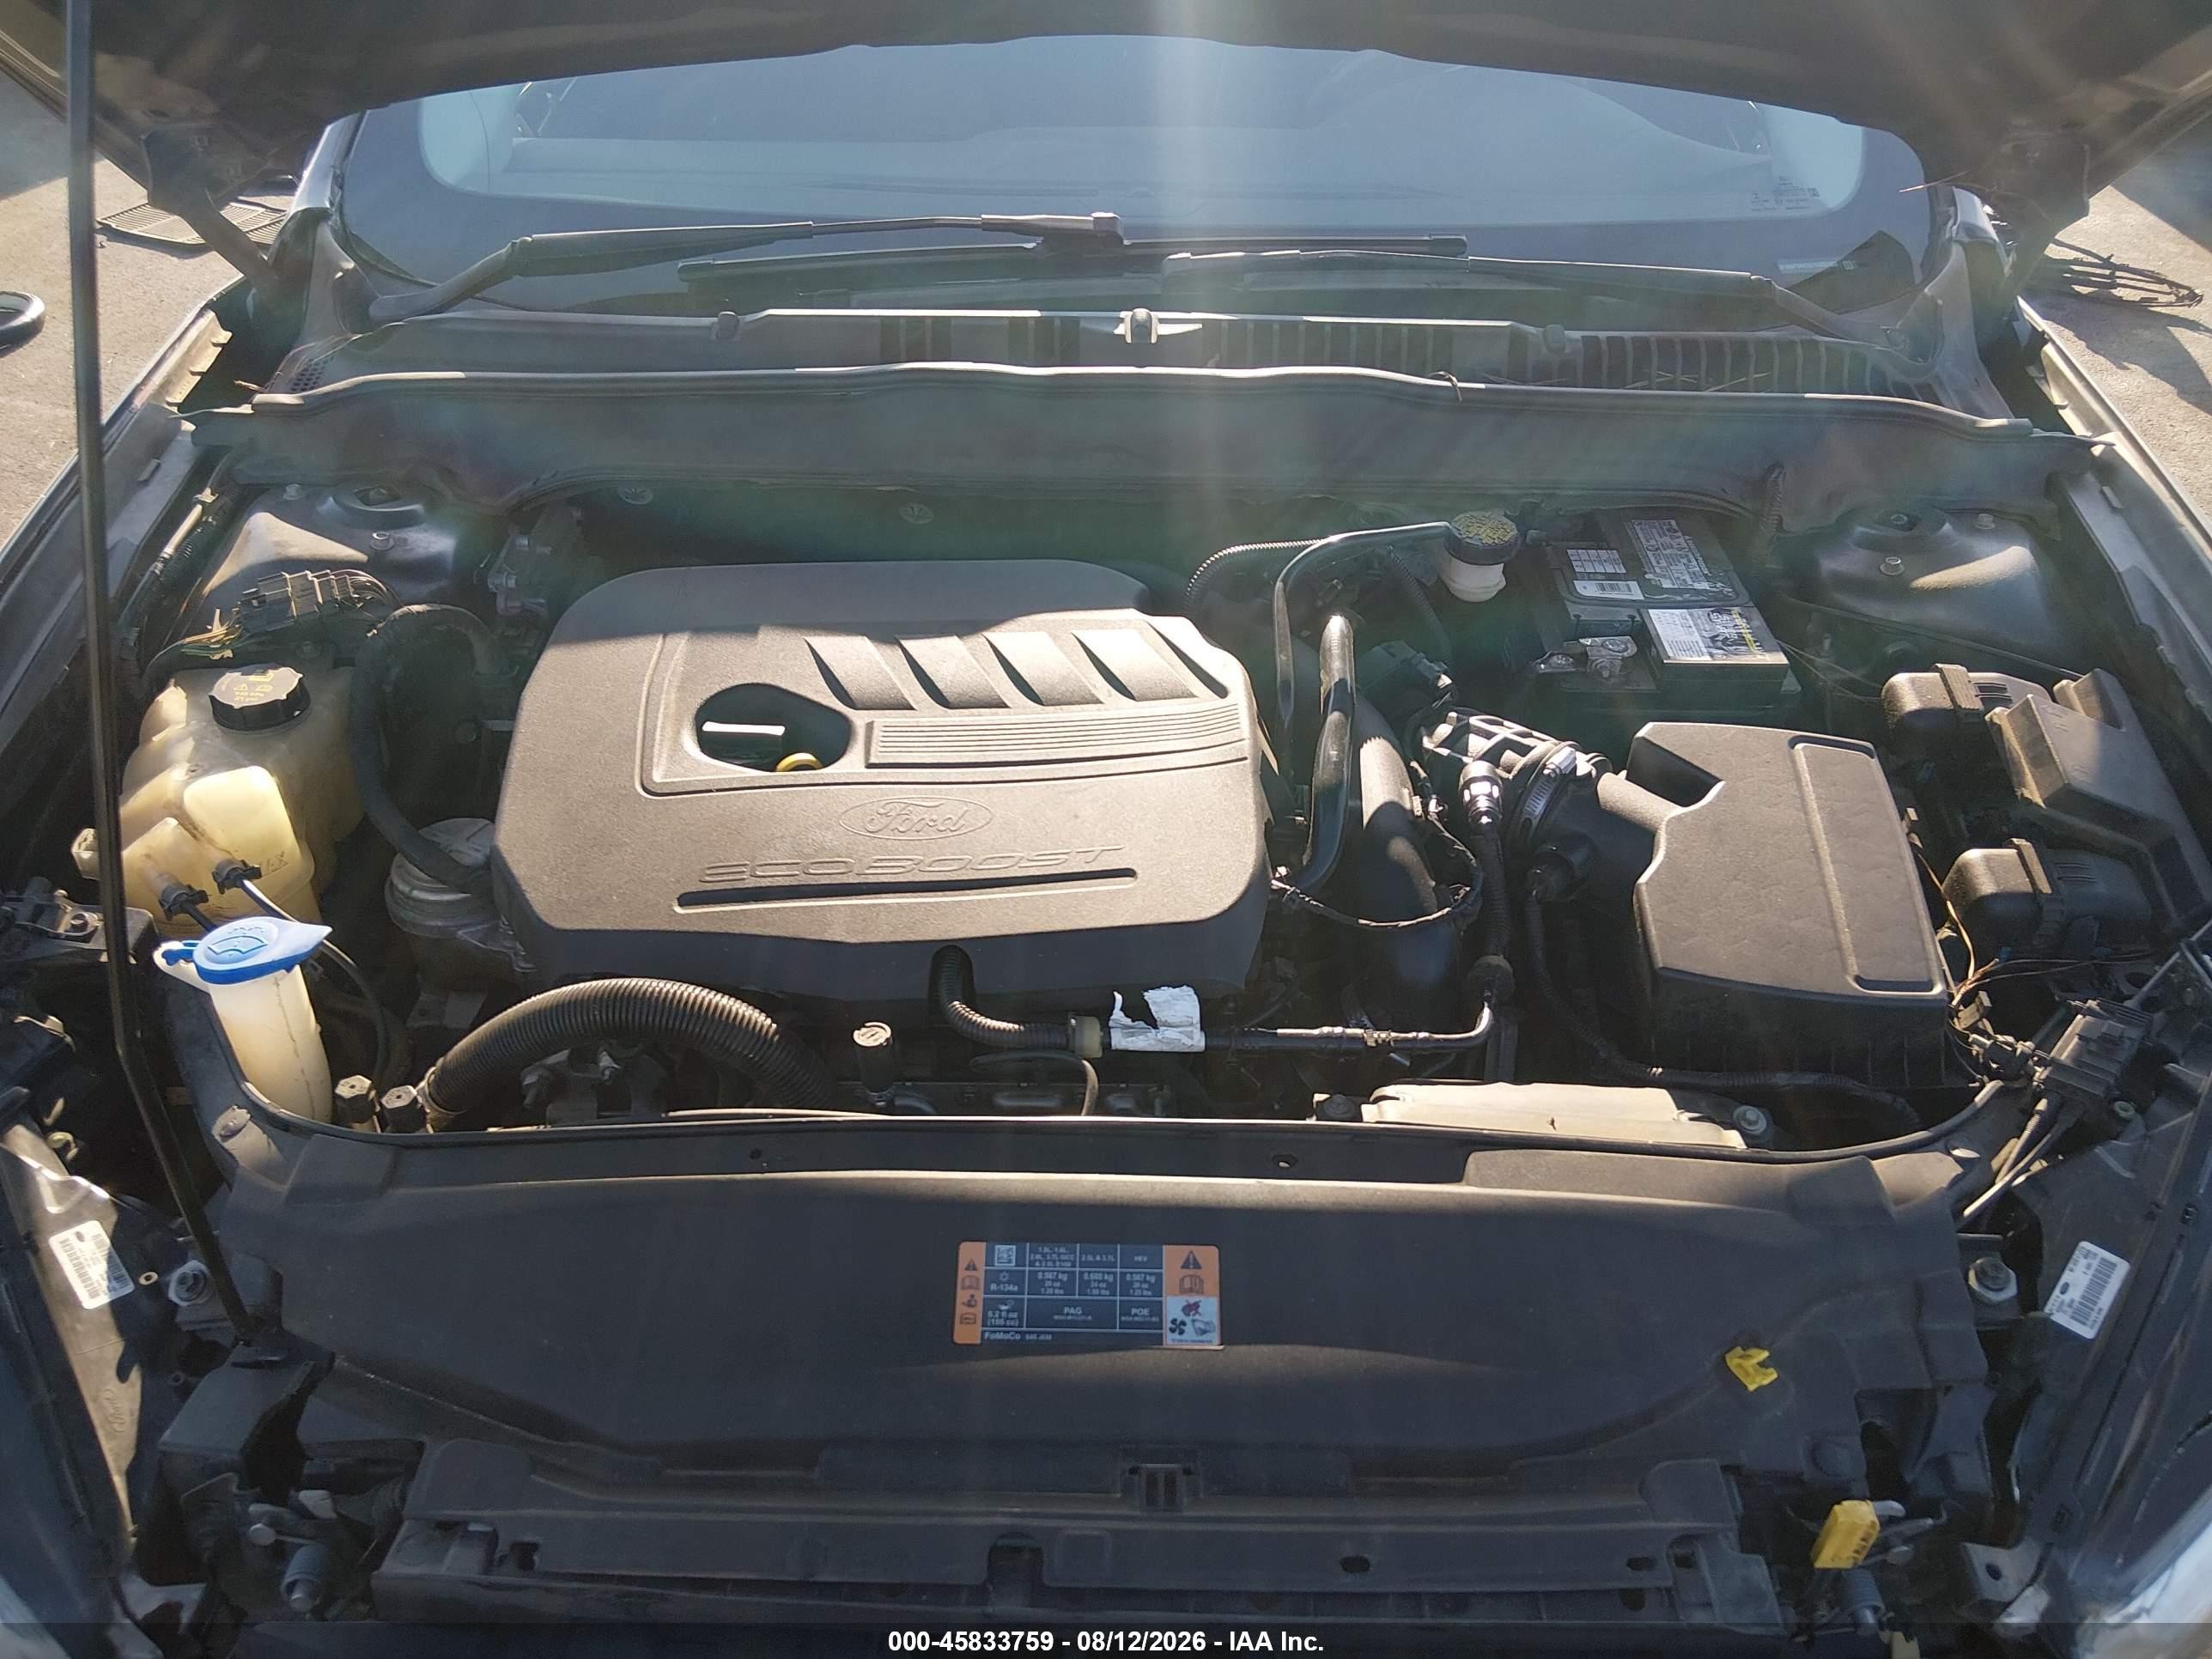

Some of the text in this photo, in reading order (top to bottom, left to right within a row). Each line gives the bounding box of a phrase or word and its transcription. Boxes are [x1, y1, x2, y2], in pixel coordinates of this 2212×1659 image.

[865, 800, 969, 834] Ford
[699, 845, 1127, 884] ECOBOOST
[1058, 1272, 1068, 1282] kg
[1103, 1273, 1114, 1283] kg
[1146, 1273, 1156, 1284] kg
[990, 1283, 1019, 1291] R-134a
[1064, 1306, 1082, 1316] PAG
[1131, 1307, 1150, 1316] POE
[984, 1331, 1021, 1340] FoMoCo
